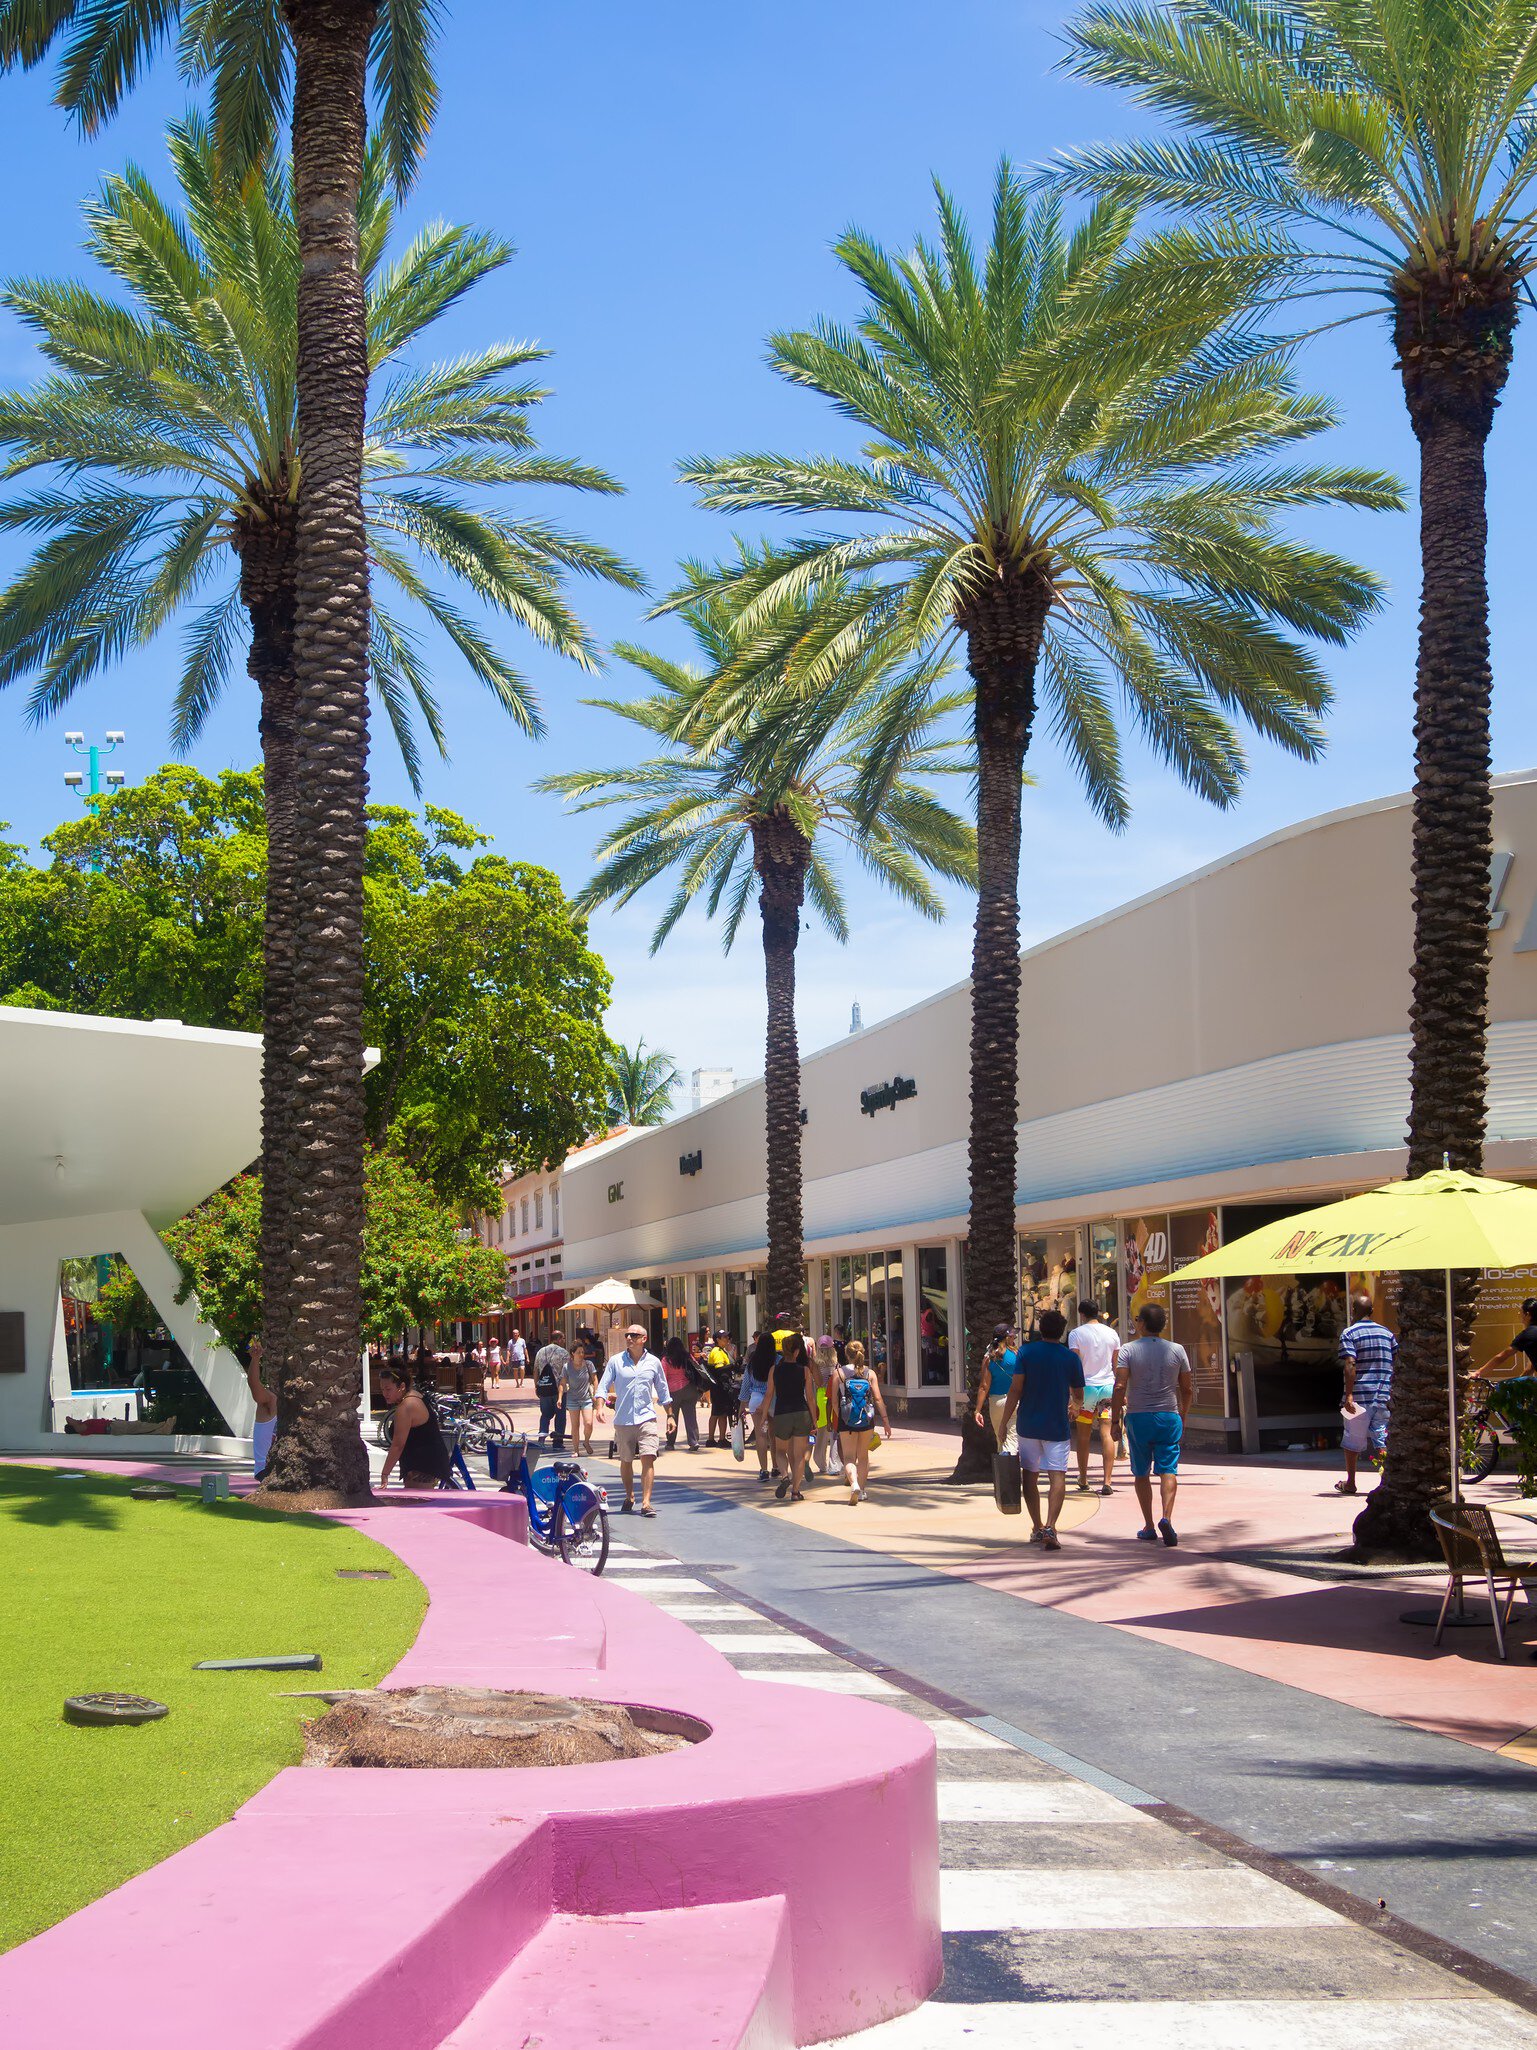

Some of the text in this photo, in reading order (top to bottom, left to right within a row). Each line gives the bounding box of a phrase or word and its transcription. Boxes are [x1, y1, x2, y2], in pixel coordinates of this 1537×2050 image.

[608, 1181, 624, 1203] GNC
[1144, 1232, 1167, 1264] 4D
[1147, 1289, 1165, 1298] Closed
